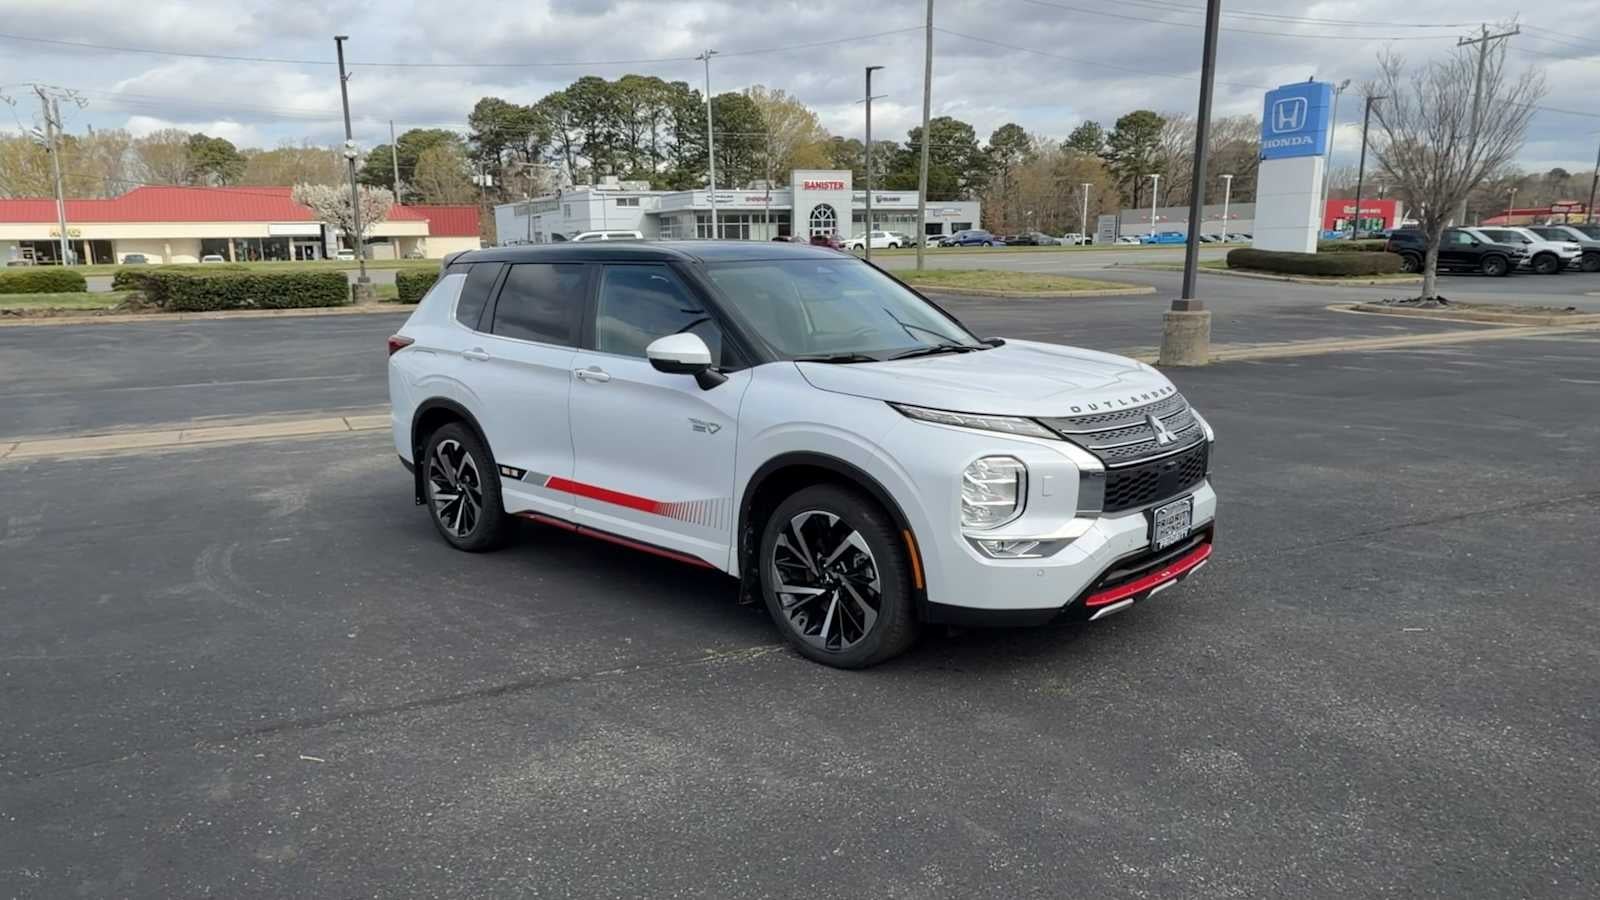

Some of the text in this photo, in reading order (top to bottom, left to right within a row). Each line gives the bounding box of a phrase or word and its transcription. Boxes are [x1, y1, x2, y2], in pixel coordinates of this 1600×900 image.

[1263, 136, 1313, 149] HONDA
[804, 180, 845, 190] BANISTER
[1070, 386, 1173, 413] OUTLANDER
